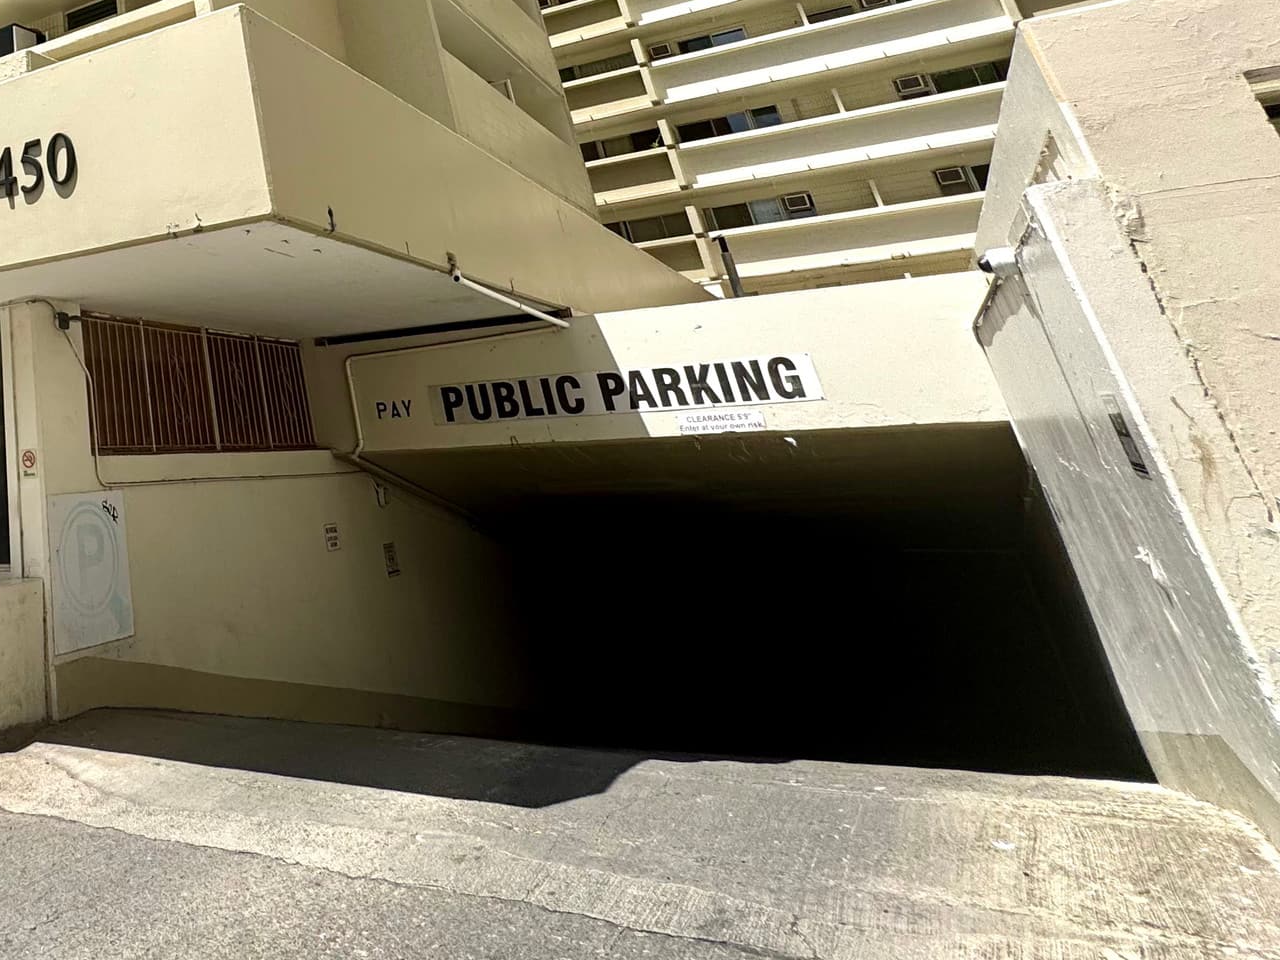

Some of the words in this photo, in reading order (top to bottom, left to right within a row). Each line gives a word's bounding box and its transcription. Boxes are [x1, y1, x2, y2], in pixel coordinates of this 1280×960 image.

[375, 399, 412, 420] PAY
[439, 375, 585, 423] PUBLIC
[596, 356, 807, 412] PARKING
[686, 413, 736, 423] CLEARANCE
[679, 424, 699, 432] Enter
[710, 424, 727, 432] your
